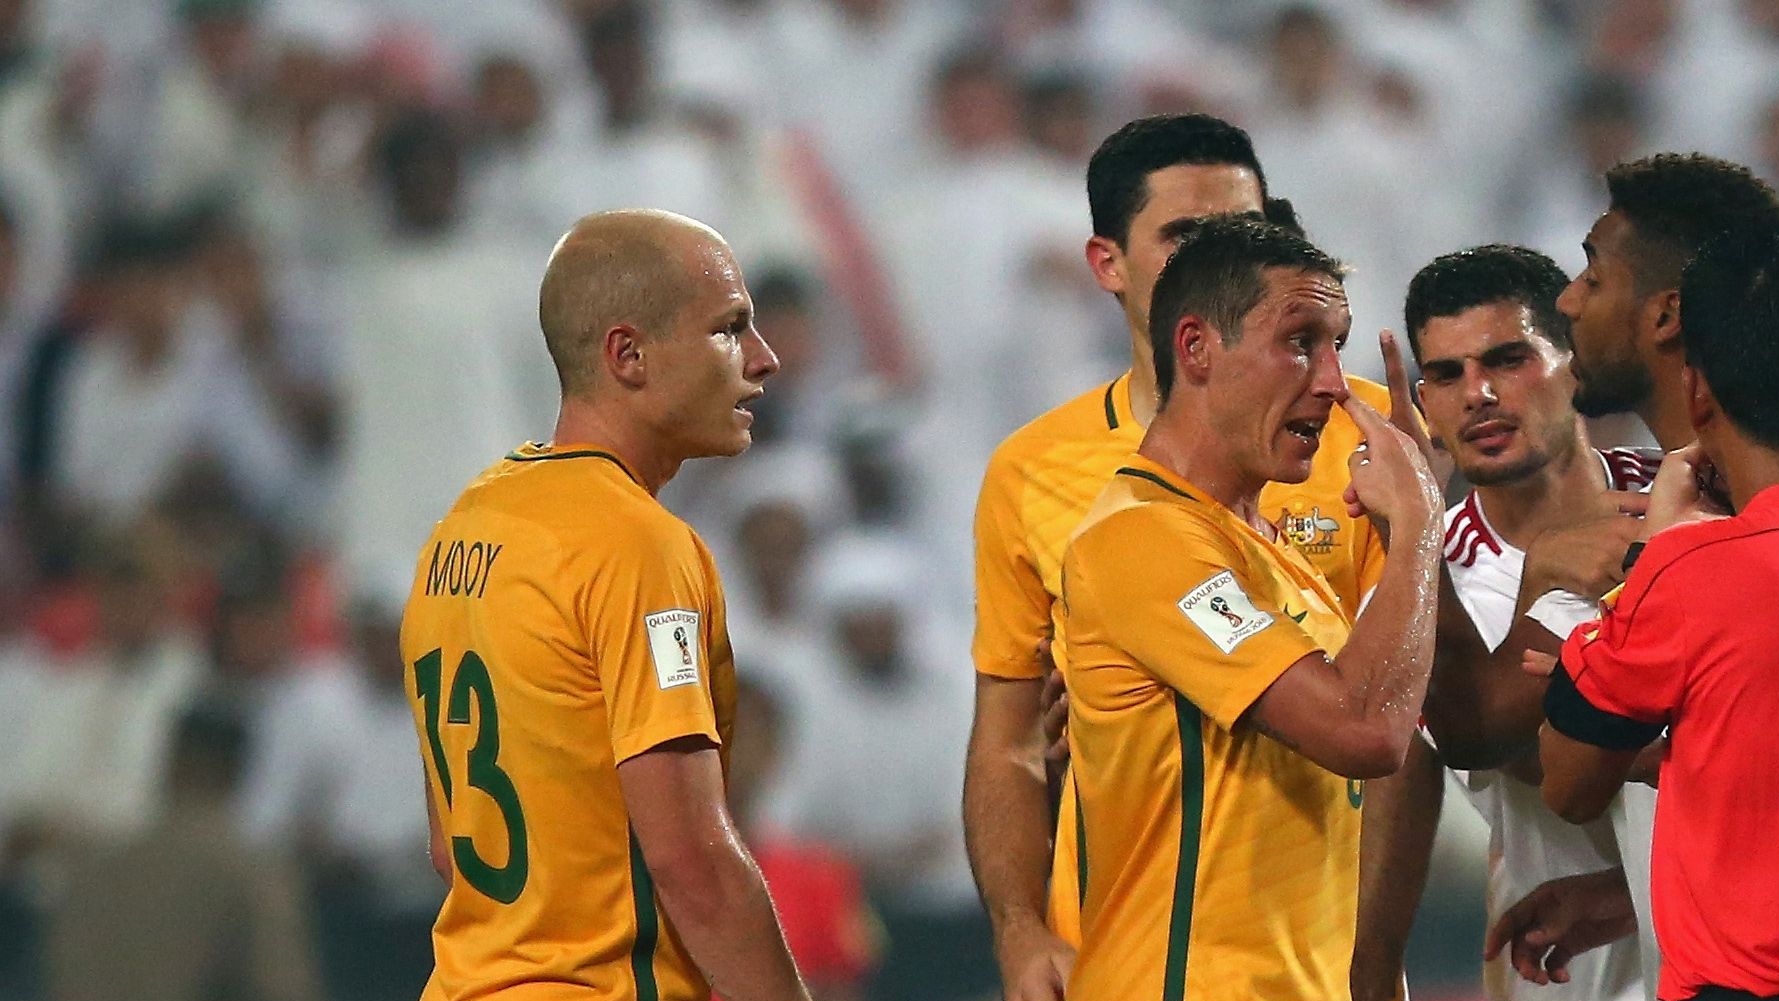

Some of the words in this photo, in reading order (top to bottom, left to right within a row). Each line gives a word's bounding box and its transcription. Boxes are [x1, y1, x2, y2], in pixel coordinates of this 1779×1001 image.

[425, 540, 503, 599] MOOY
[1183, 575, 1233, 610] QUALIFIERS
[414, 648, 528, 905] 13
